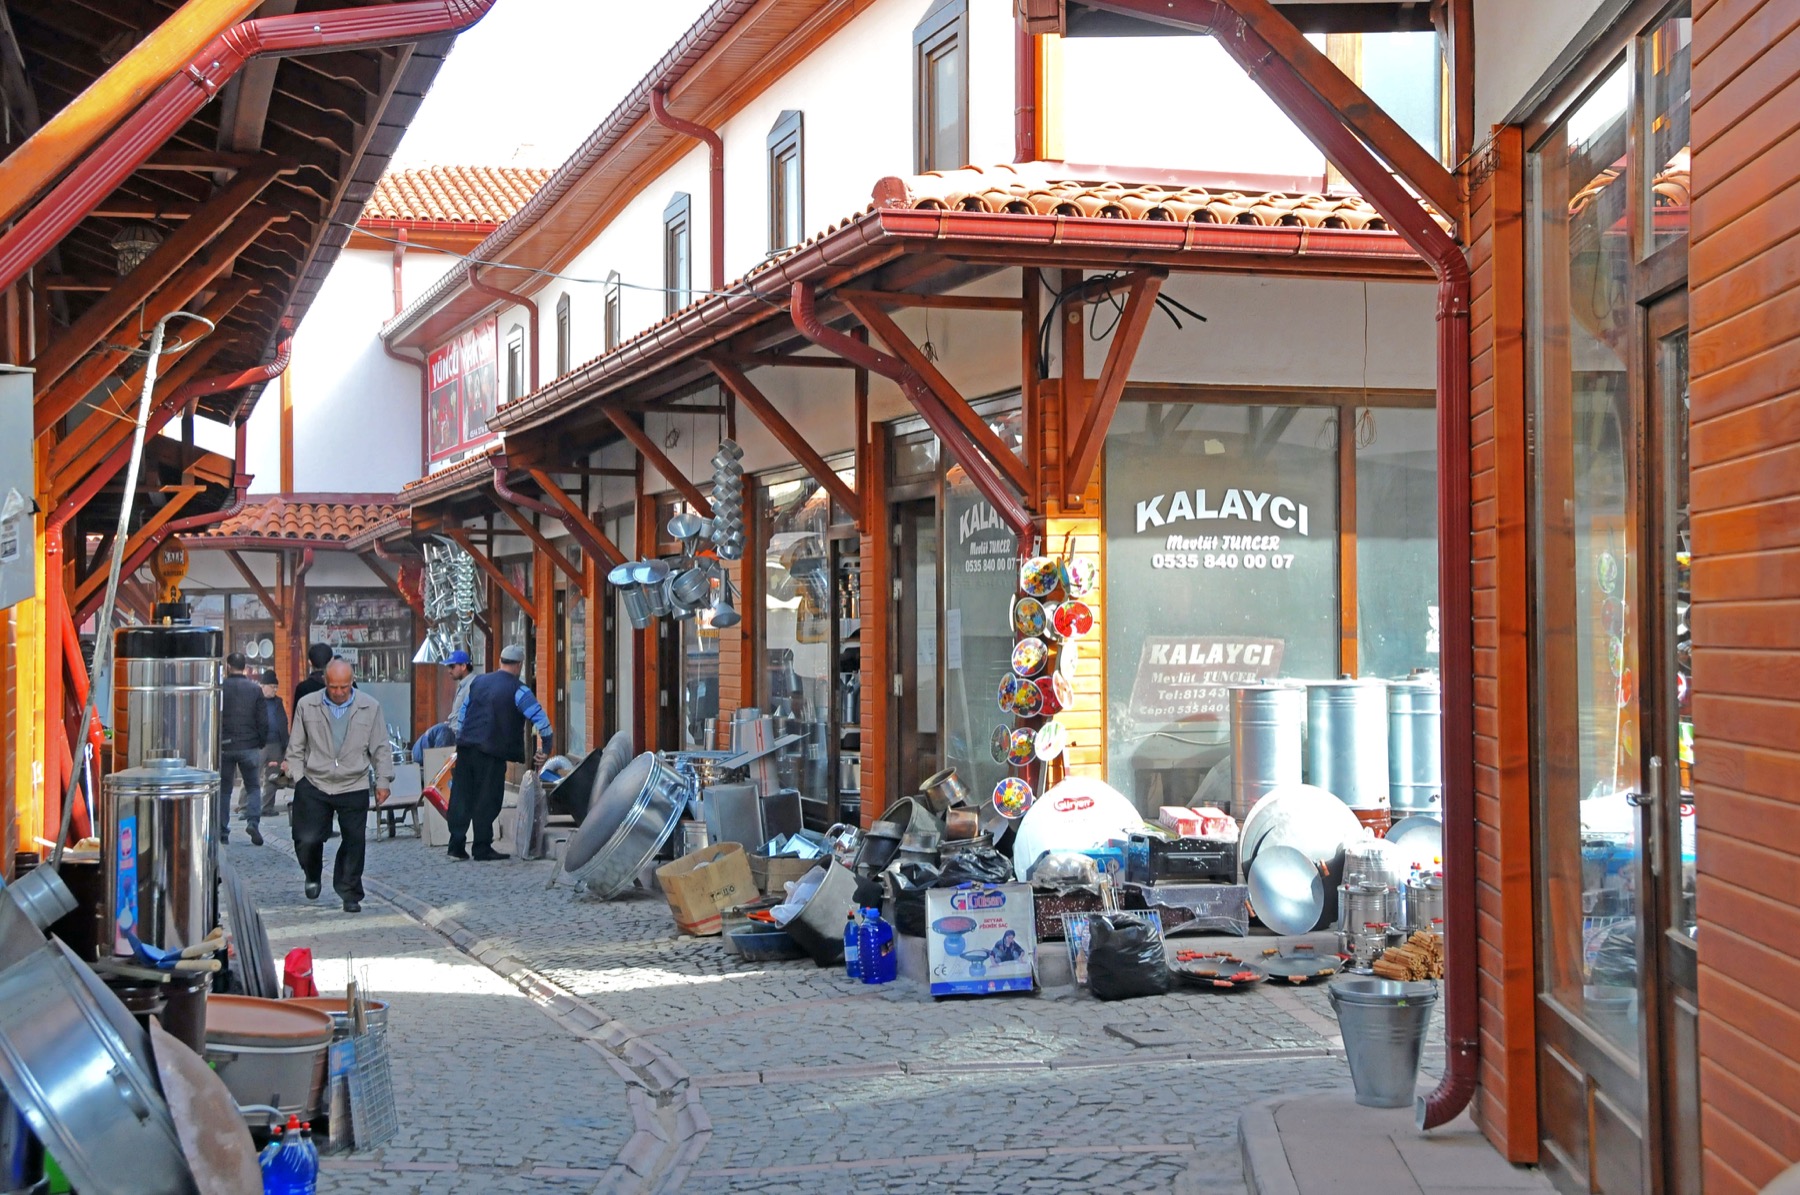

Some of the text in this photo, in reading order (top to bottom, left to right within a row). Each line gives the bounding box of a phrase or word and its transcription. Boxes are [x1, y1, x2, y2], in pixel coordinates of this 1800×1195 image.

[1136, 488, 1309, 536] KALAYCI
[1165, 534, 1218, 551] Mevlüt
[965, 557, 1016, 573] 0535 840 00 07
[1152, 553, 1295, 570] 0535 840 00 07
[1149, 643, 1275, 666] KALAYCI
[1151, 672, 1197, 684] Mevlüt
